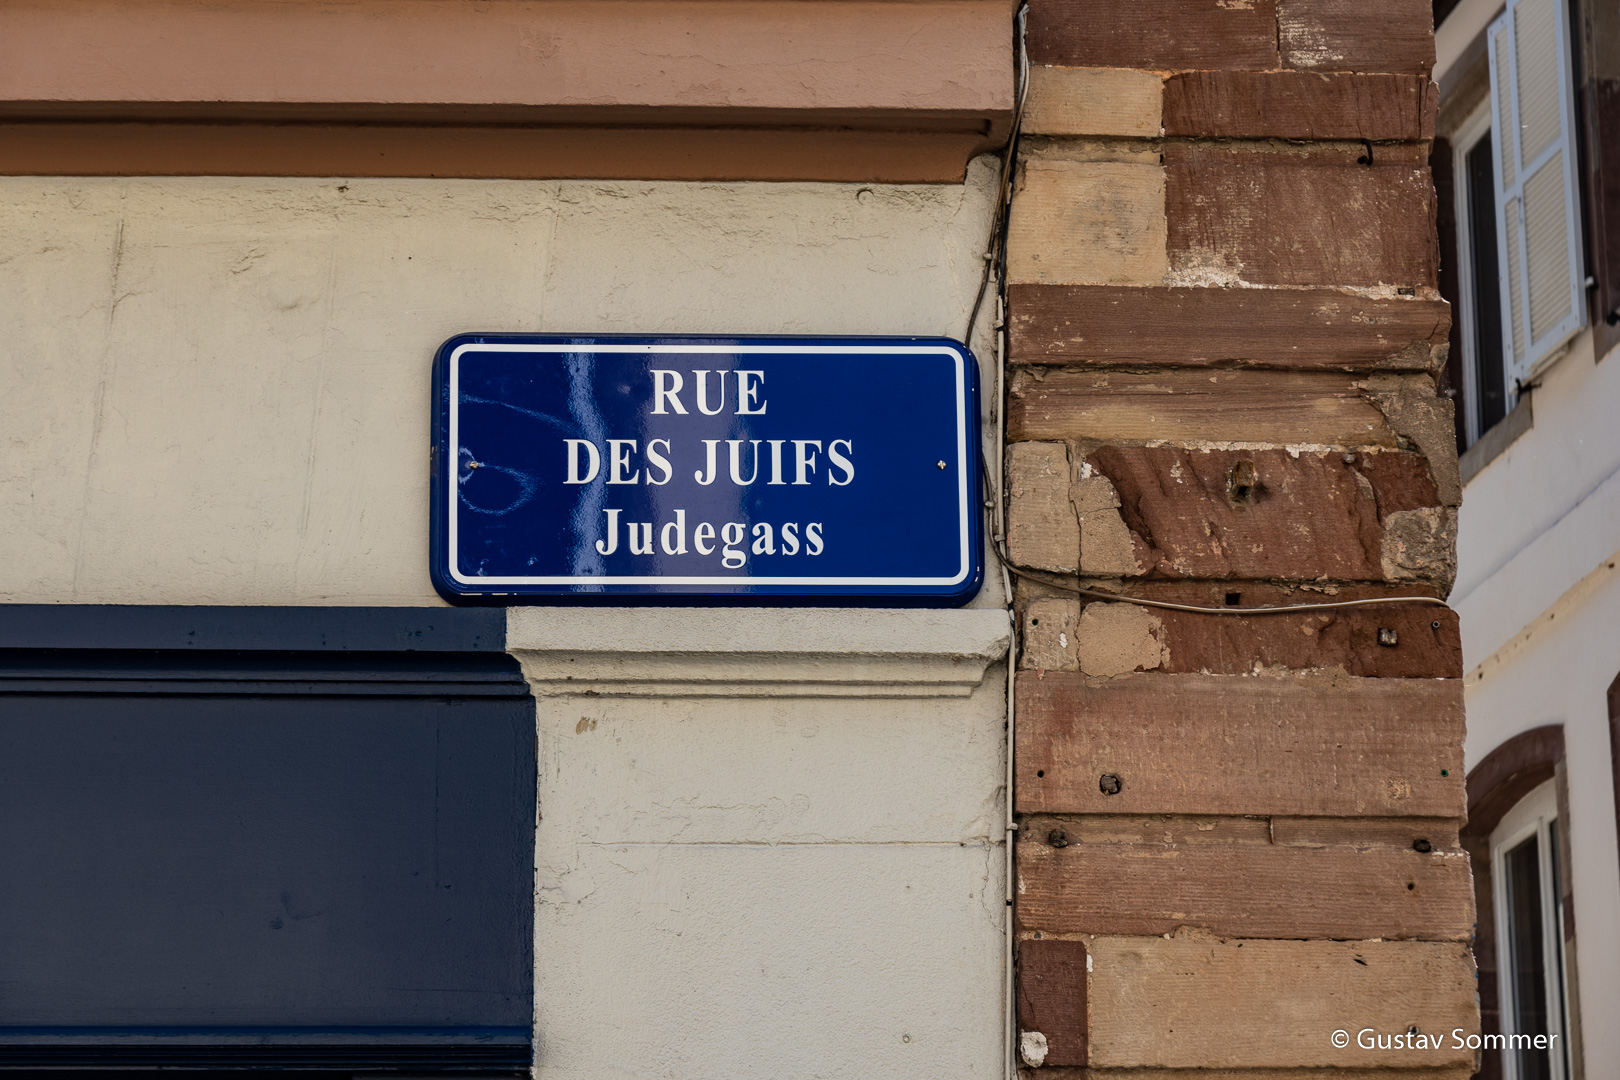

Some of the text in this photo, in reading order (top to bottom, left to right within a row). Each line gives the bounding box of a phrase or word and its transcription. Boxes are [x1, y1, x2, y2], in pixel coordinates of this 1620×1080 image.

[650, 369, 767, 416] RUE
[563, 439, 855, 486] DES JUIFS
[595, 509, 824, 569] Judegass
